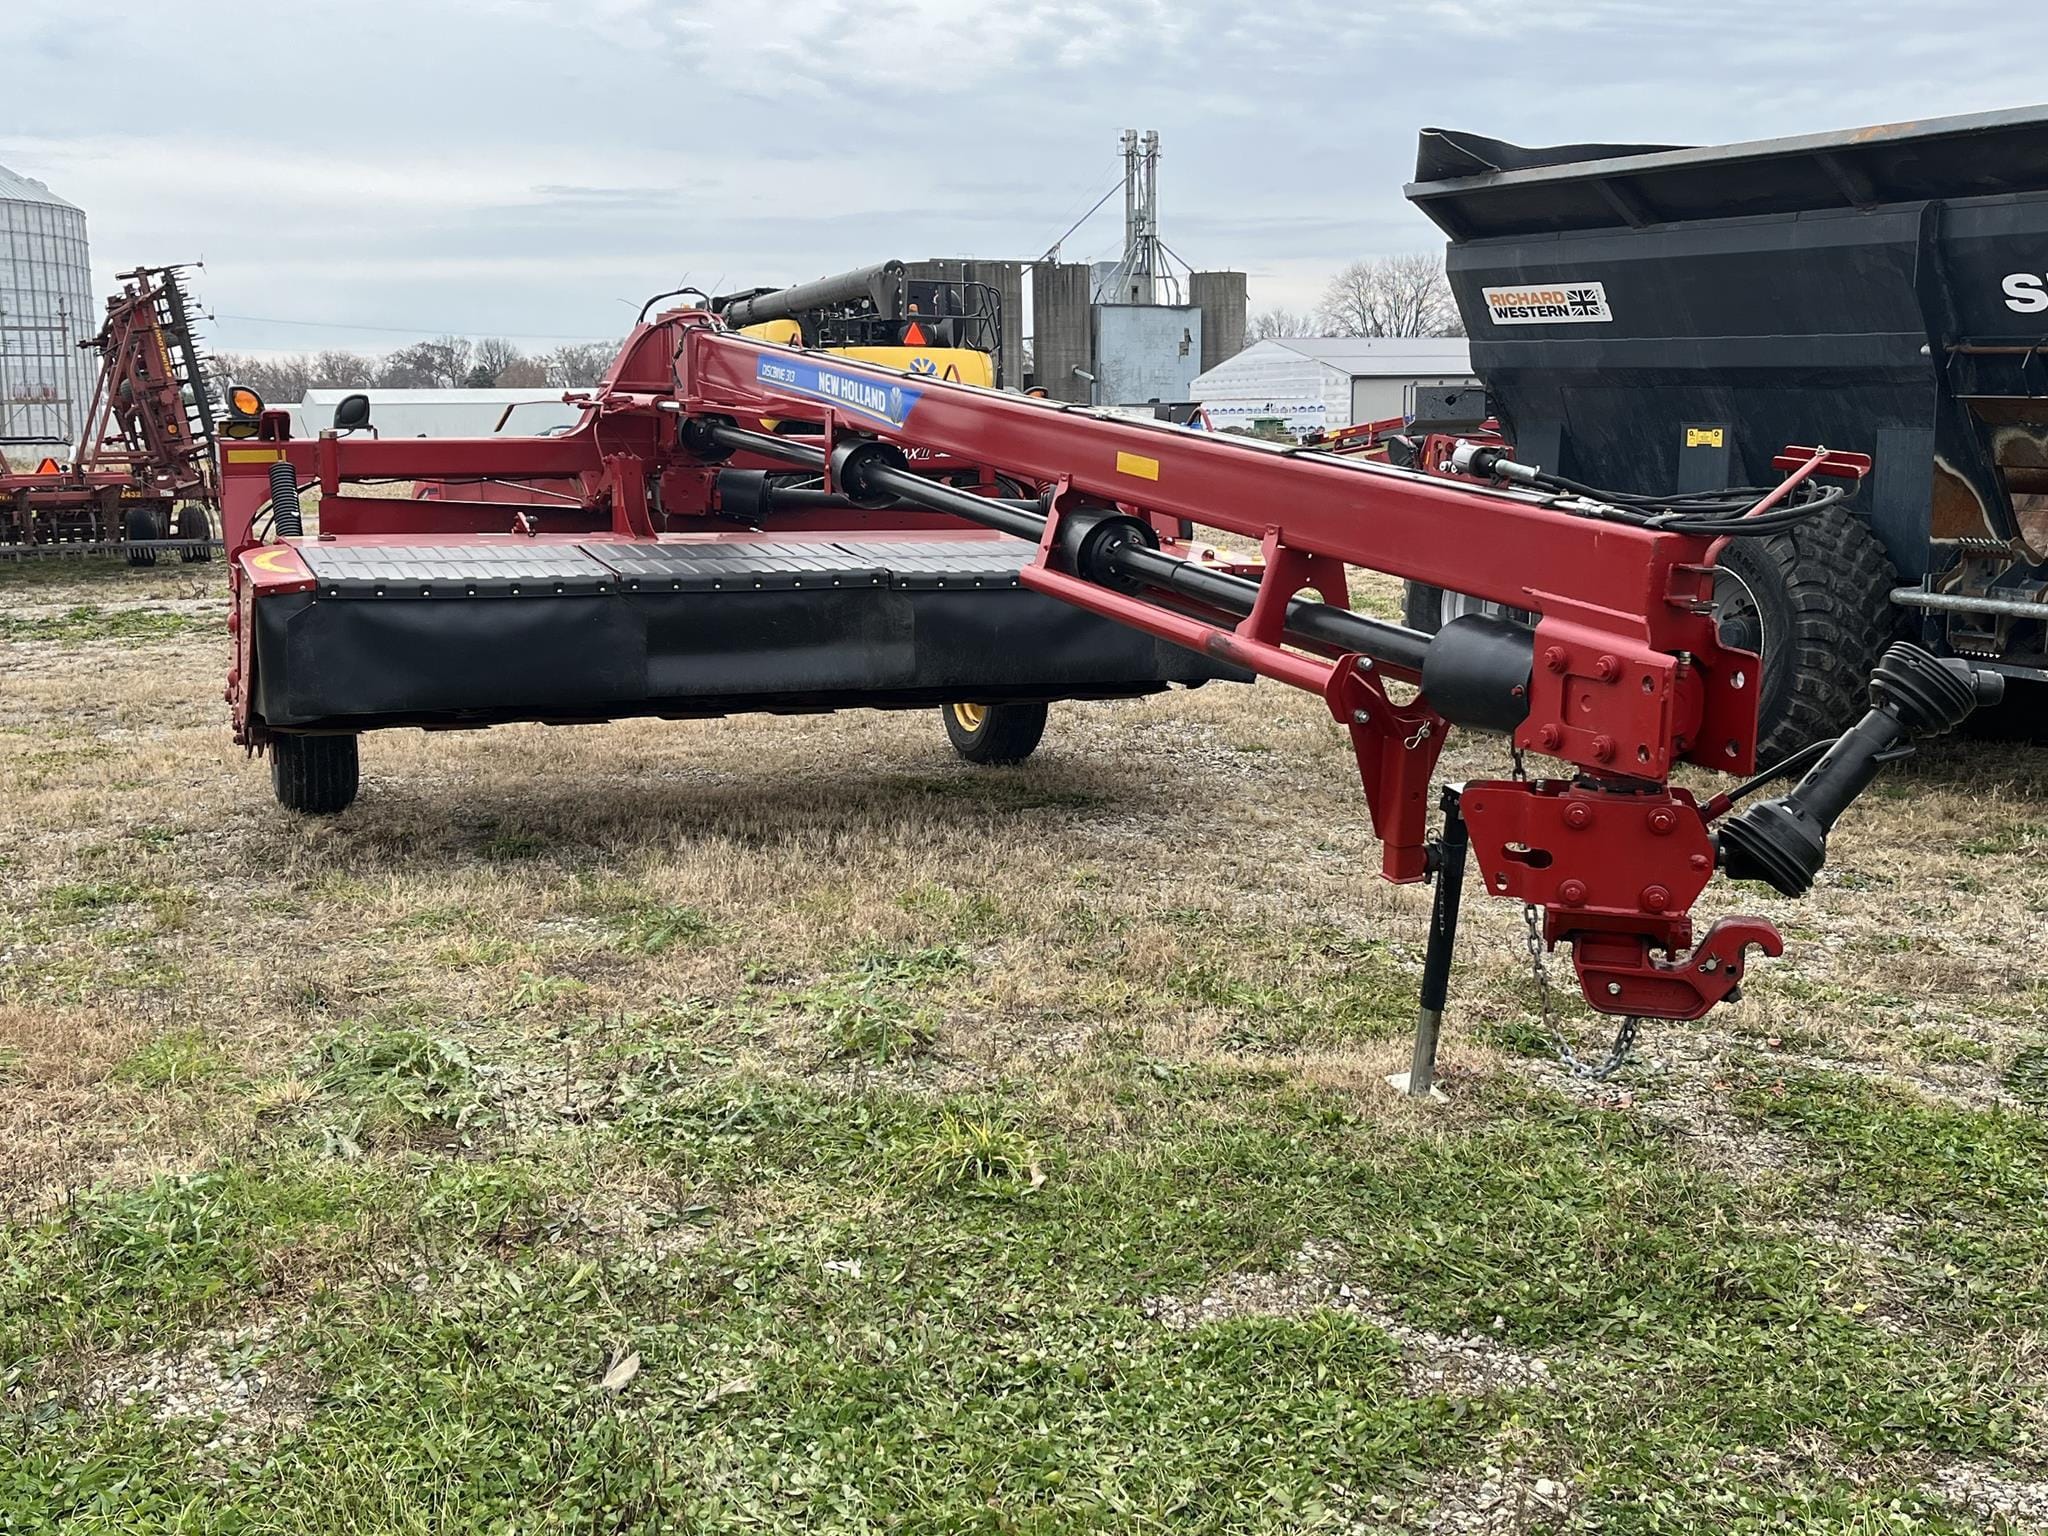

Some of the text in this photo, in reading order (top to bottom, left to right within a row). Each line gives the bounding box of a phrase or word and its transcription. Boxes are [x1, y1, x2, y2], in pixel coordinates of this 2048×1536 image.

[1489, 291, 1566, 306] RICHARD
[2002, 273, 2048, 313] S
[1494, 304, 1570, 318] WESTERN
[818, 371, 886, 412] NEW HOLLAND
